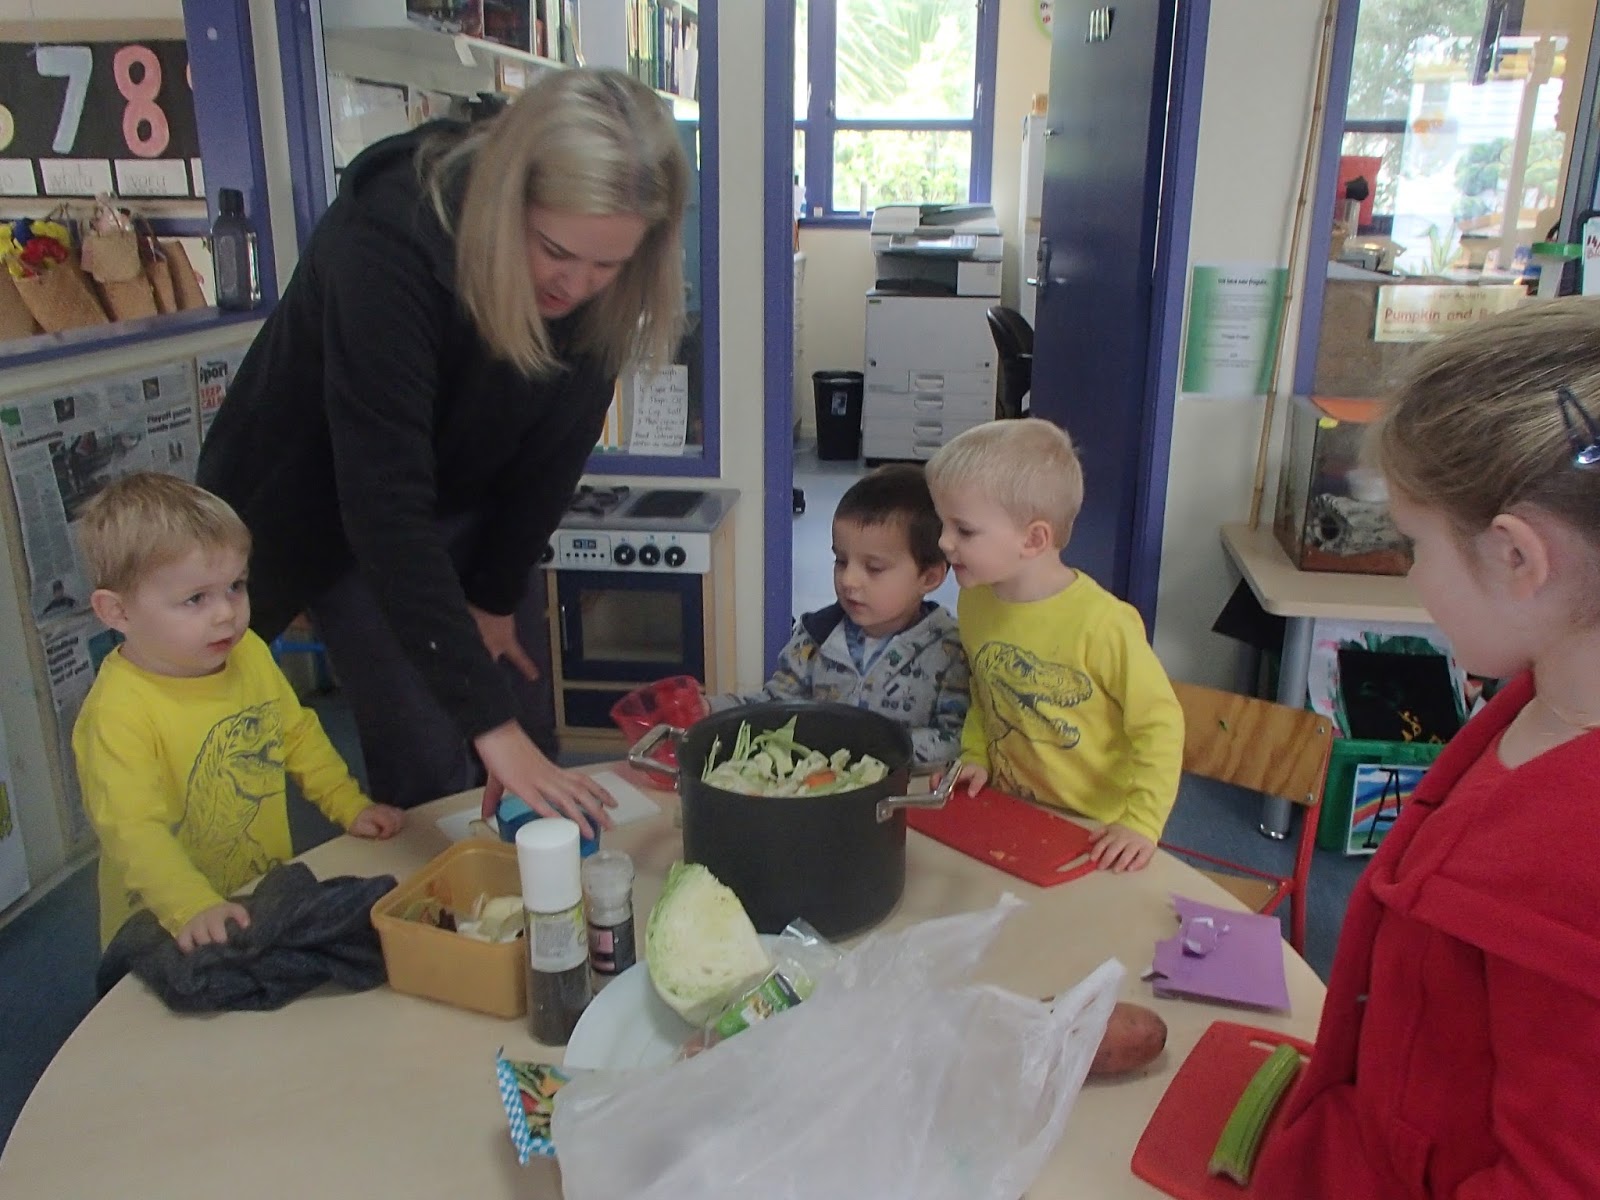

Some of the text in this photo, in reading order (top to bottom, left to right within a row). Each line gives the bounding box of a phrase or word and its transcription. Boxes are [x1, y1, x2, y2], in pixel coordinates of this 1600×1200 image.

[36, 45, 93, 154] 7
[113, 44, 170, 158] 8
[1384, 306, 1440, 323] Pumpkin
[1446, 307, 1473, 321] and
